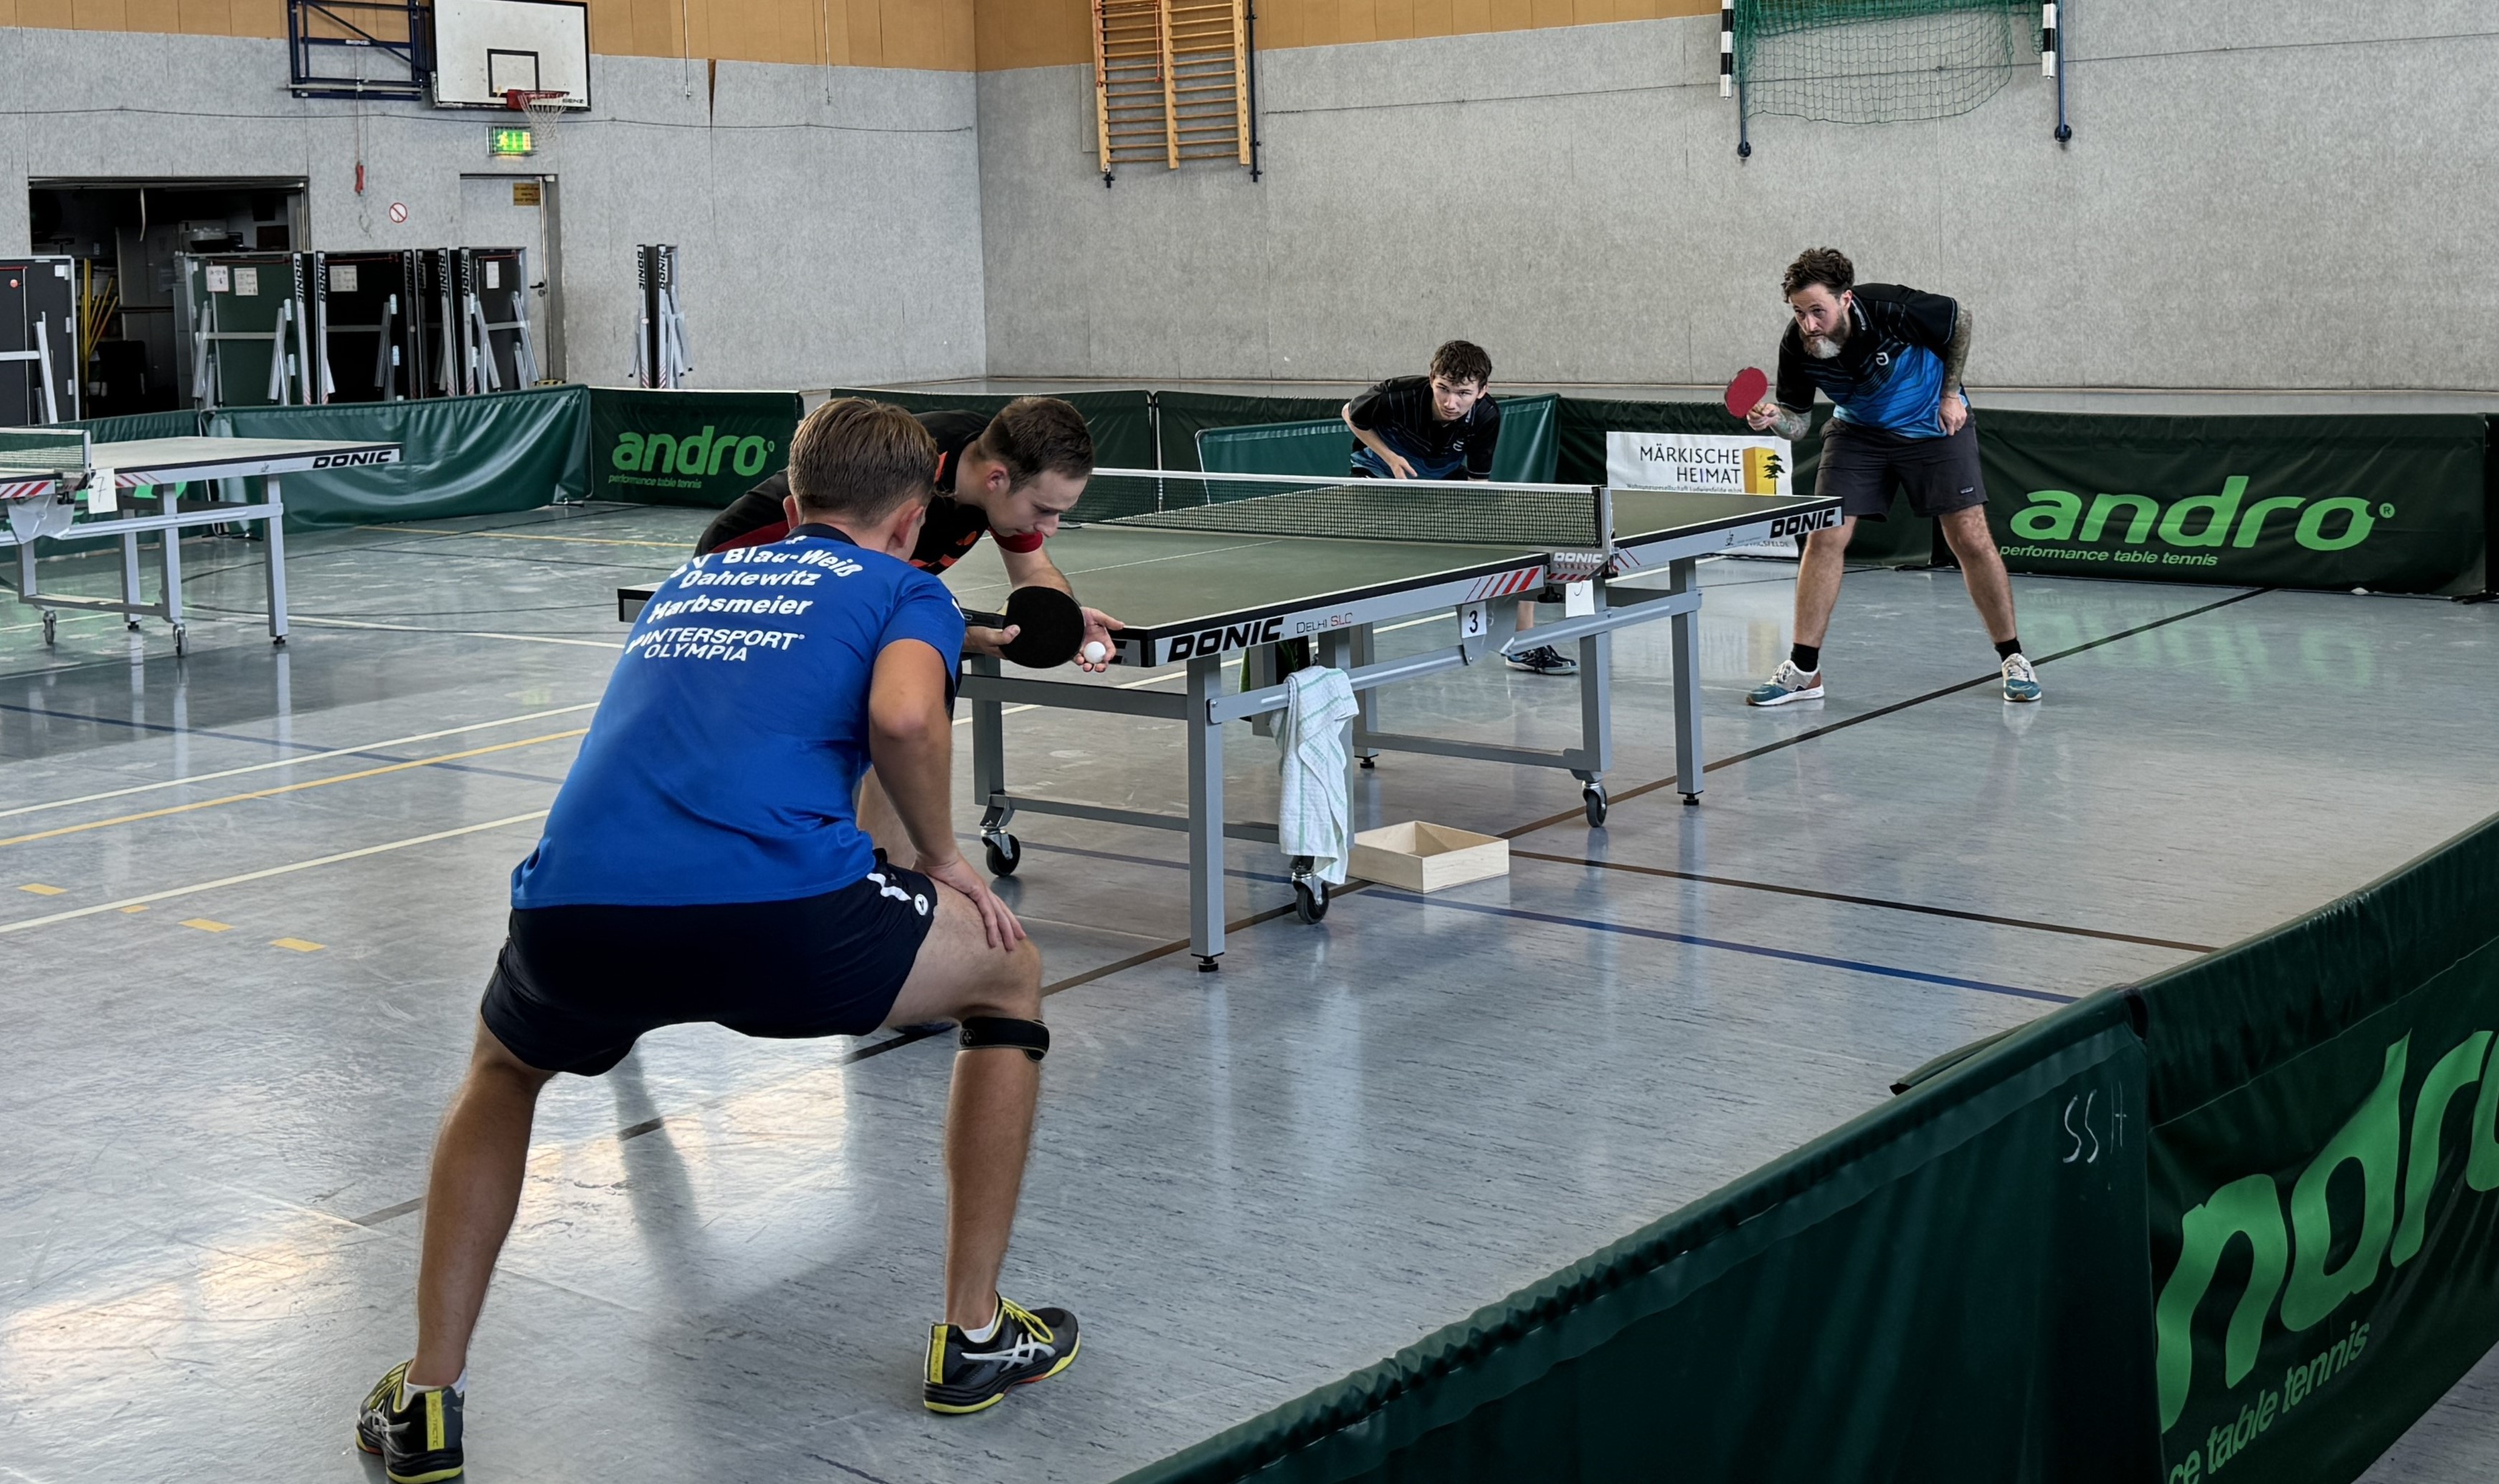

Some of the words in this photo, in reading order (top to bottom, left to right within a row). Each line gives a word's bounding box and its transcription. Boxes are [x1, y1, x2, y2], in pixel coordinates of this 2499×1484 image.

[295, 259, 304, 303] DONIC
[440, 255, 448, 298] DONIC
[313, 451, 392, 469] DONIC
[612, 426, 767, 476] andro
[1640, 443, 1740, 465] MÄRKISCHE
[1677, 467, 1741, 484] HEIMAT
[96, 477, 106, 503] 7
[1770, 509, 1836, 538] DONIC
[2010, 476, 2376, 551] andro
[722, 546, 863, 577] Blau-Weiß
[1553, 552, 1603, 563] DONIC
[1999, 544, 2109, 562] performance
[2114, 550, 2158, 564] table
[2162, 552, 2218, 566] tennis
[678, 569, 822, 589] Dahlewitz
[646, 594, 814, 624] Harbsmeier
[1469, 610, 1478, 633] 3
[641, 627, 798, 650] INTERSPORT
[1167, 617, 1284, 663] DONIC
[1331, 612, 1353, 627] SLC
[644, 643, 747, 662] OLYMPIA
[2207, 1389, 2278, 1475] table
[2282, 1320, 2370, 1414] tennis
